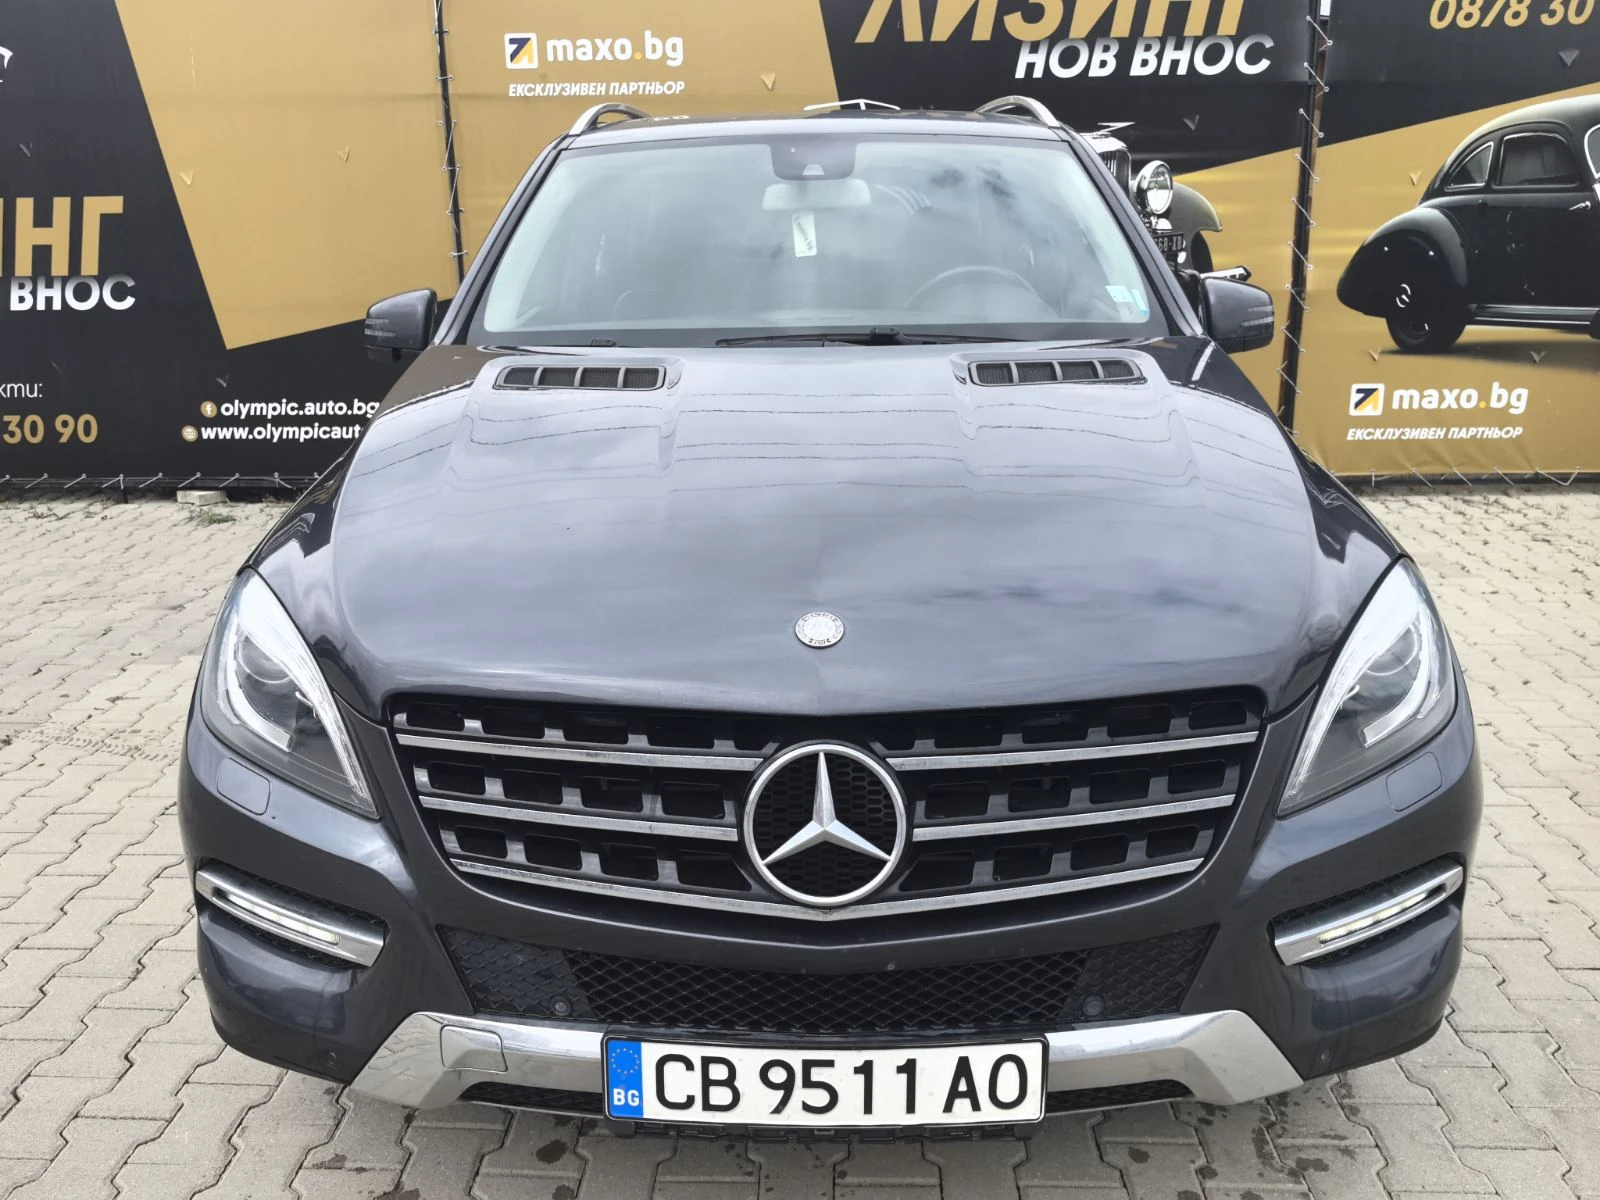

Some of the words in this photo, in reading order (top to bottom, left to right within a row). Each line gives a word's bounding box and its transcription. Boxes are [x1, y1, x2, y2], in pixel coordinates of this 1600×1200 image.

[546, 30, 684, 67] maxo.bg
[1014, 36, 1118, 79] НОВ
[1129, 33, 1275, 77] ВНОС
[508, 82, 606, 97] ЕКСКЛУЗИВЕН
[609, 80, 686, 96] ПАРТНЬОР
[10, 274, 136, 311] ВНОС
[1392, 381, 1529, 415] maxo.bg
[3, 414, 45, 444] 30
[54, 413, 98, 444] 90
[201, 422, 363, 443] www.olympicaut
[1346, 427, 1446, 441] ЕКСКЛУЗИВЕН
[1448, 426, 1524, 440] ПАРТНЬОР
[612, 1087, 640, 1107] BG
[655, 1053, 741, 1113] CB
[758, 1057, 918, 1115] 9511
